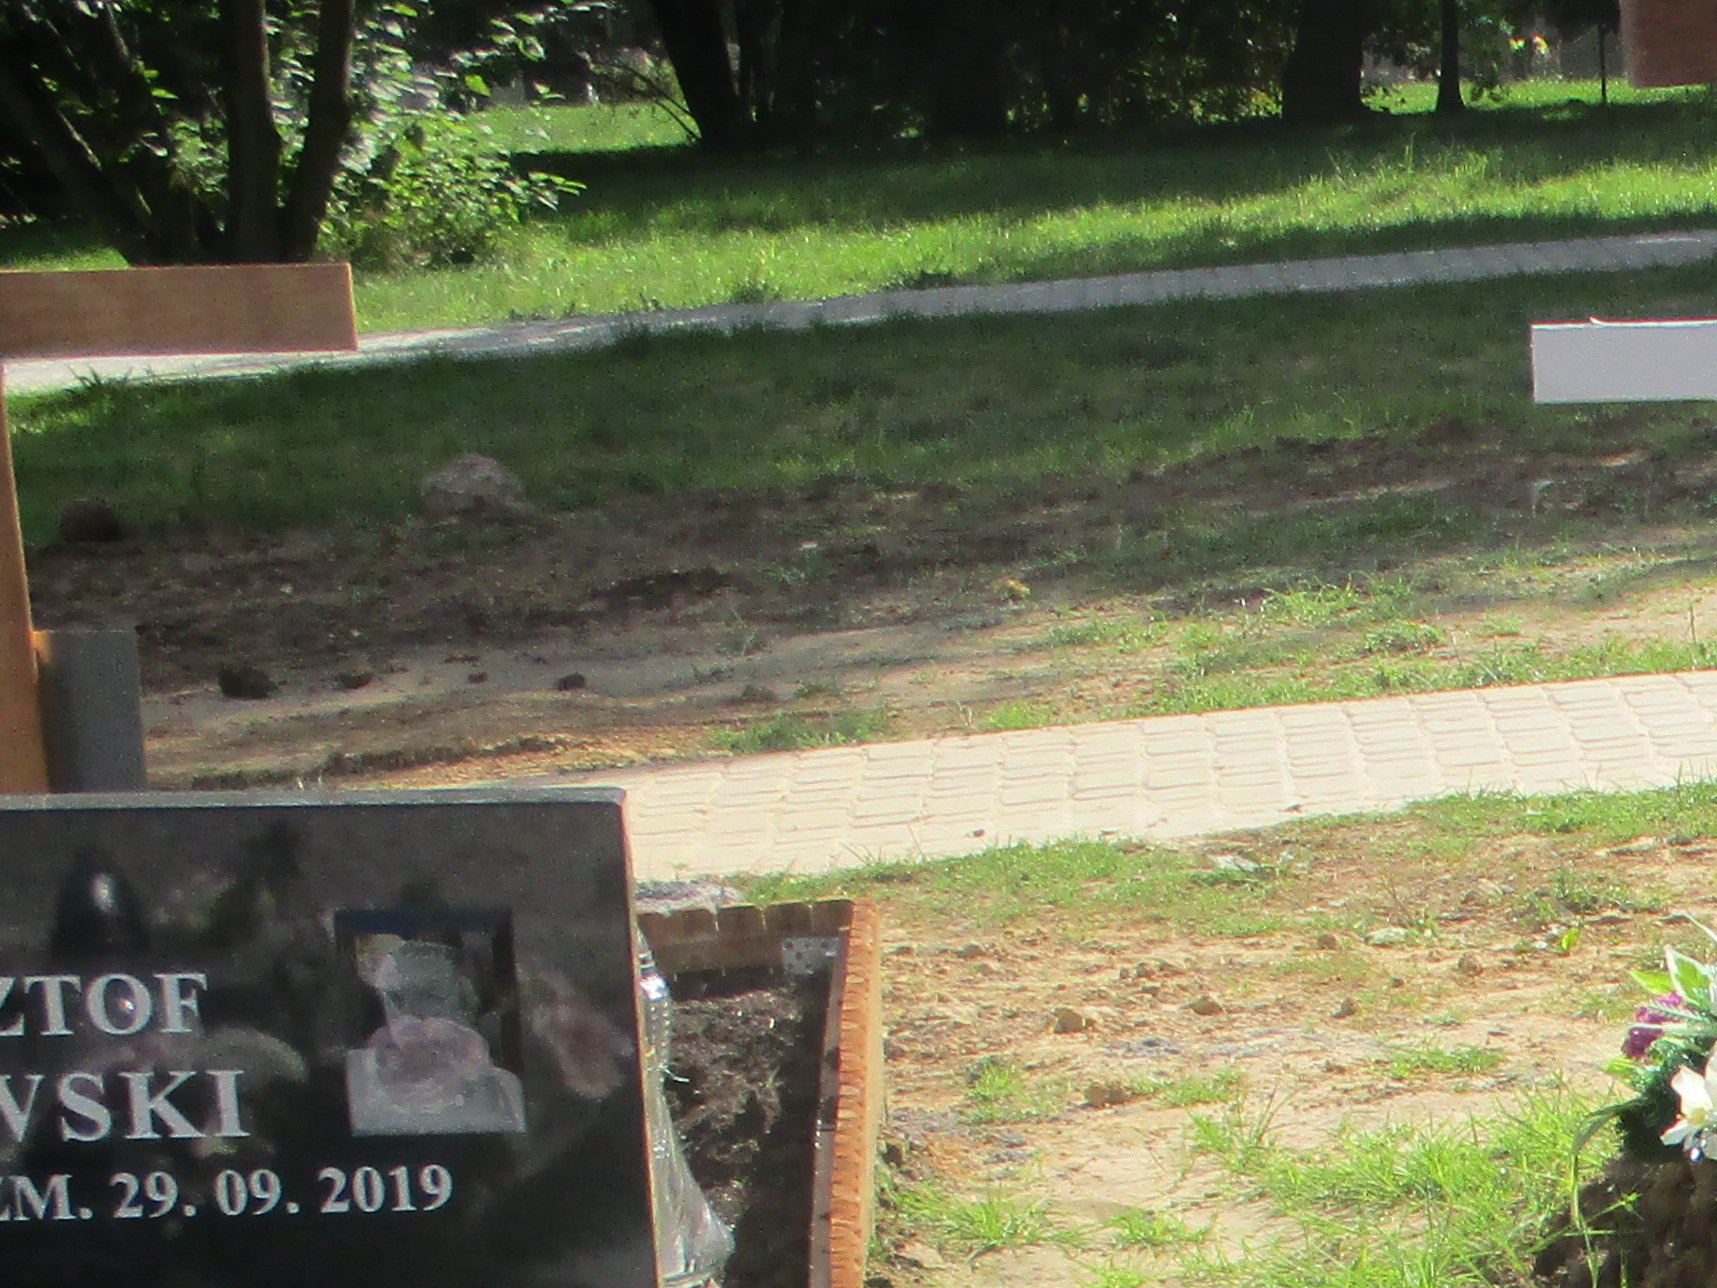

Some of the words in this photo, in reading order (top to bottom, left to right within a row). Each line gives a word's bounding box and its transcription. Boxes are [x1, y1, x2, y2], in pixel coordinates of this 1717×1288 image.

[0, 1173, 94, 1221] M.
[109, 1171, 197, 1218] 29.
[214, 1168, 300, 1216] 09.
[318, 1164, 453, 1213] 2019
